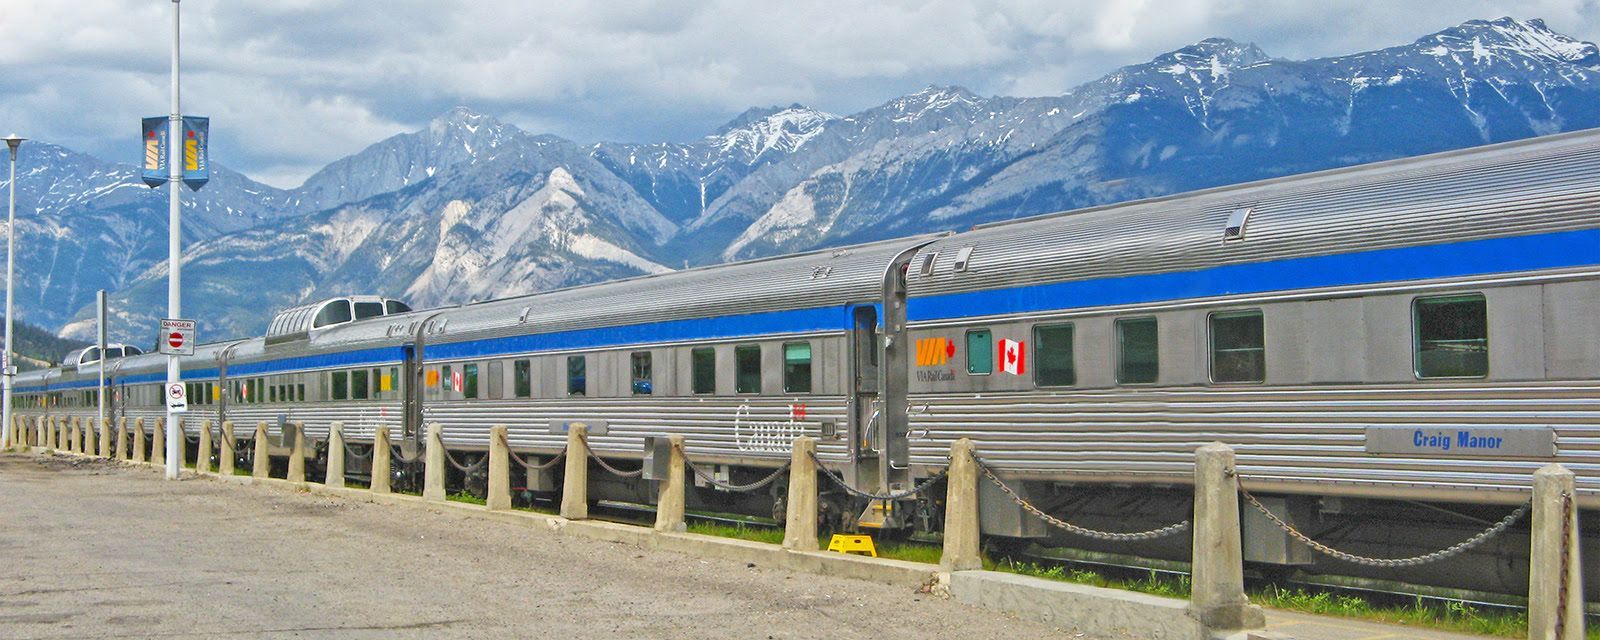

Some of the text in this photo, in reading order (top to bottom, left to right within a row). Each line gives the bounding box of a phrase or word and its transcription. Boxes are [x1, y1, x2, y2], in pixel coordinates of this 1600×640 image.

[145, 139, 159, 170] VIA
[185, 139, 198, 170] VIA
[916, 337, 946, 366] VIA
[1413, 430, 1503, 451] Craig Manor
